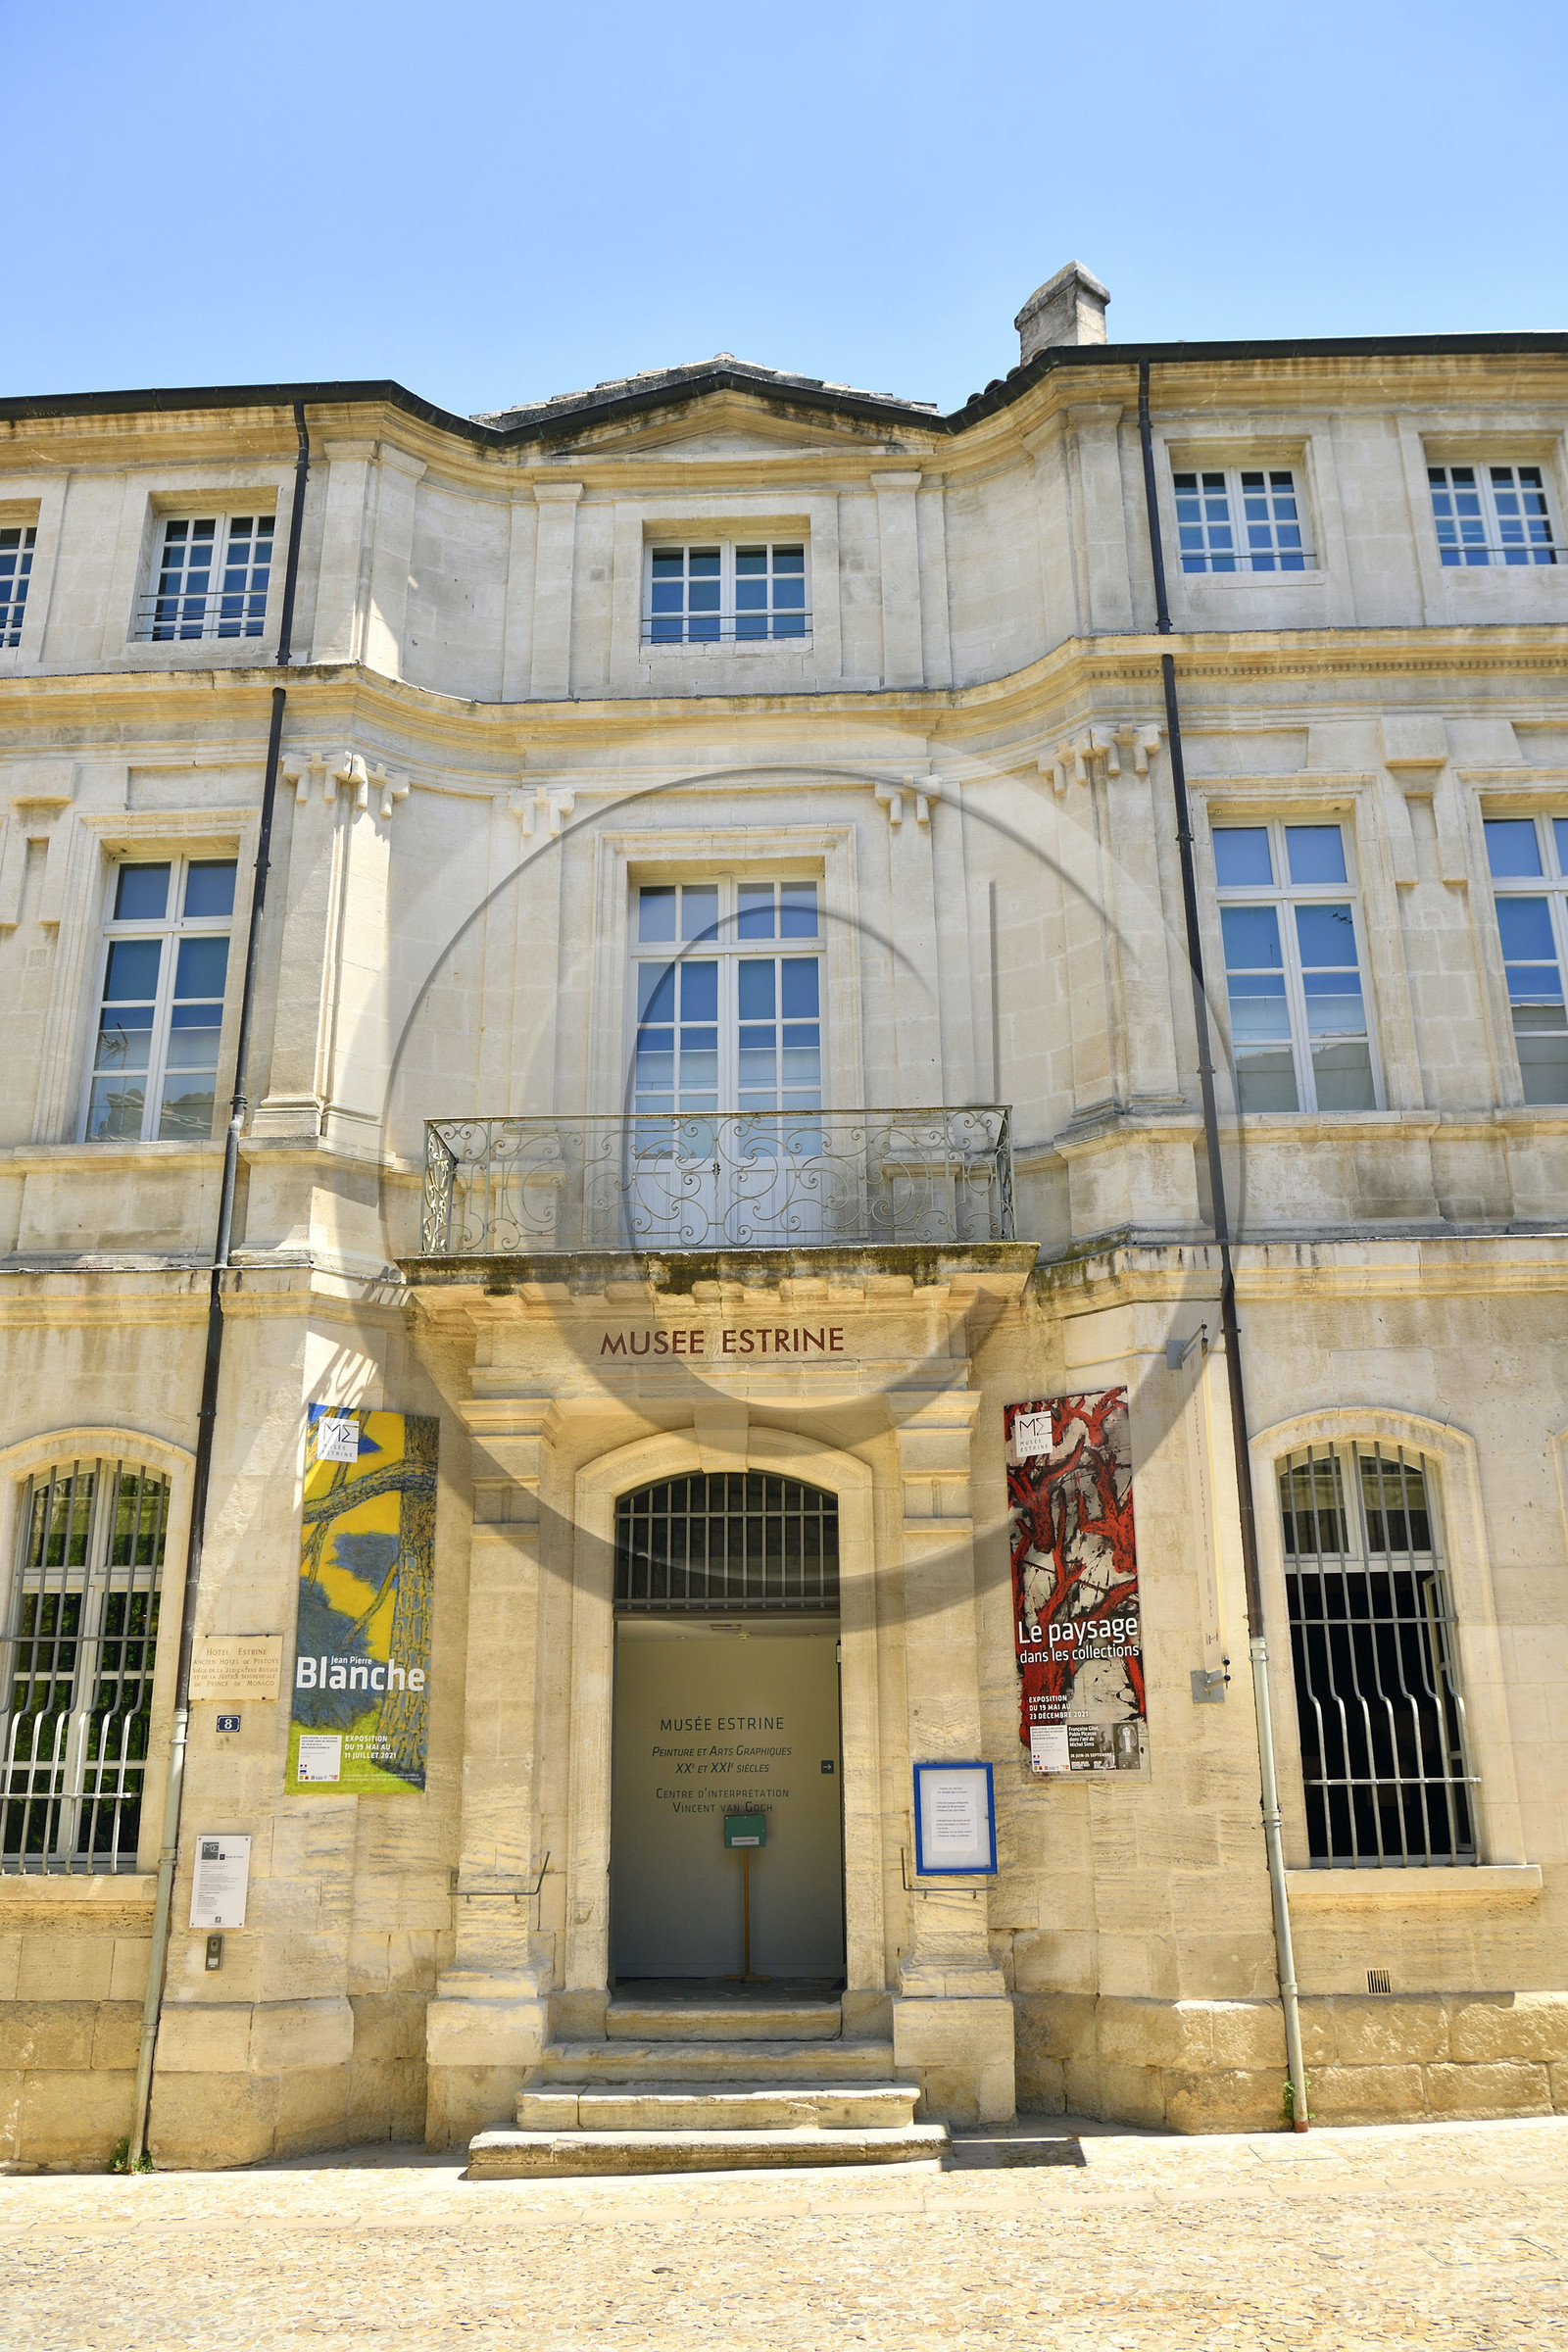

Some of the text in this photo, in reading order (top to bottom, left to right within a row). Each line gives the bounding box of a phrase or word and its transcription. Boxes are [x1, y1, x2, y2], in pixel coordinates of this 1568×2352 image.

[600, 1327, 845, 1355] MUSEE ESTRINE
[1018, 1616, 1138, 1648] Le paysage
[237, 1647, 268, 1656] ESTRINE
[1020, 1642, 1140, 1664] dans les collections
[330, 1655, 372, 1665] Jean Pierre
[296, 1655, 425, 1691] Blanche
[1028, 1694, 1068, 1703] EXPOSITION
[1038, 1711, 1072, 1720] DÉCEMBRE
[223, 1718, 233, 1730] 8
[660, 1715, 784, 1732] MUSÉE ESTRINE
[652, 1746, 695, 1757] PEINTURE
[709, 1745, 734, 1756] ARTS
[697, 1765, 709, 1774] ET
[736, 1763, 770, 1773] SIÈCLES
[656, 1788, 693, 1799] CENTRE
[672, 1801, 773, 1813] VINCENT VAN GOGH
